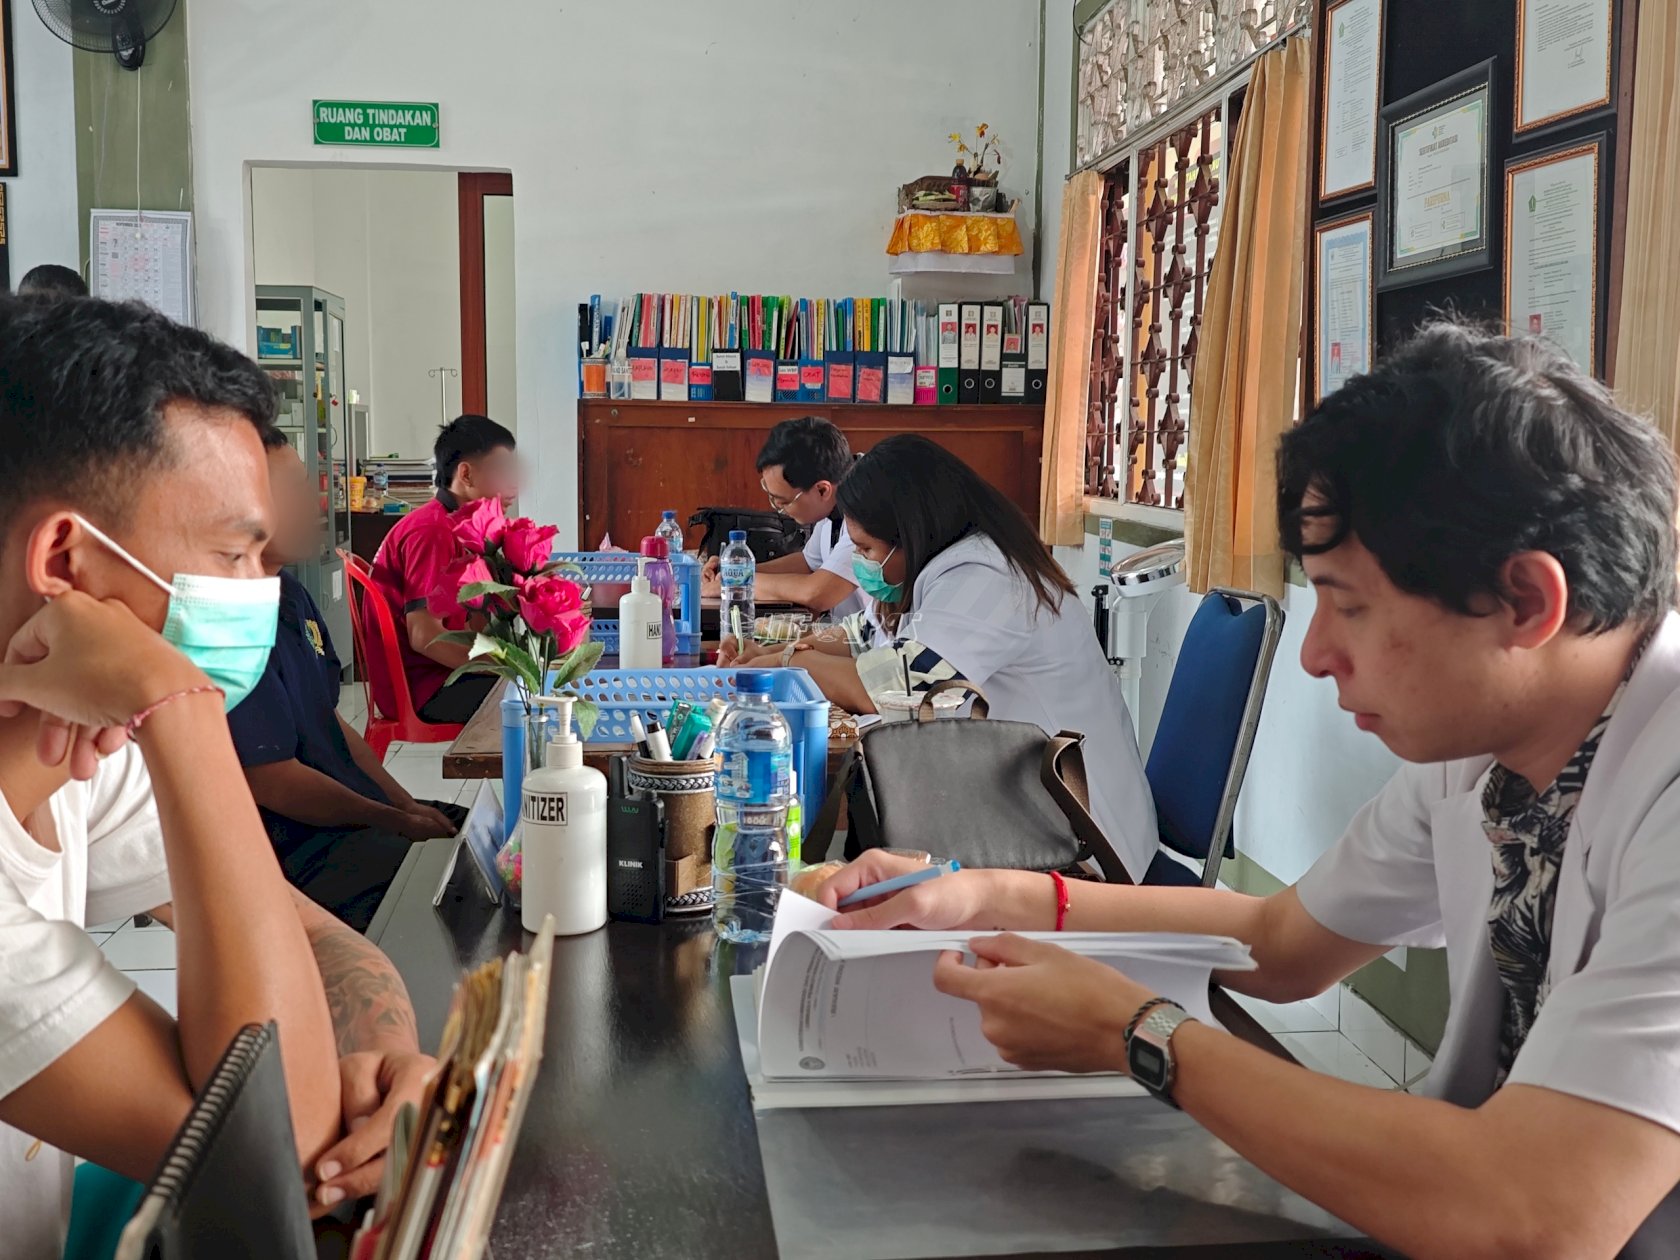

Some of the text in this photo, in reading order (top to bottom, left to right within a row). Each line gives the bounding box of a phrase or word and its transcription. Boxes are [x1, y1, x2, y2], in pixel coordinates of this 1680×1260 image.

[319, 107, 431, 126] RUANG TINDAKAN
[344, 126, 407, 141] DAN OBAT
[723, 568, 744, 578] AQUA
[618, 860, 643, 868] KLINIK
